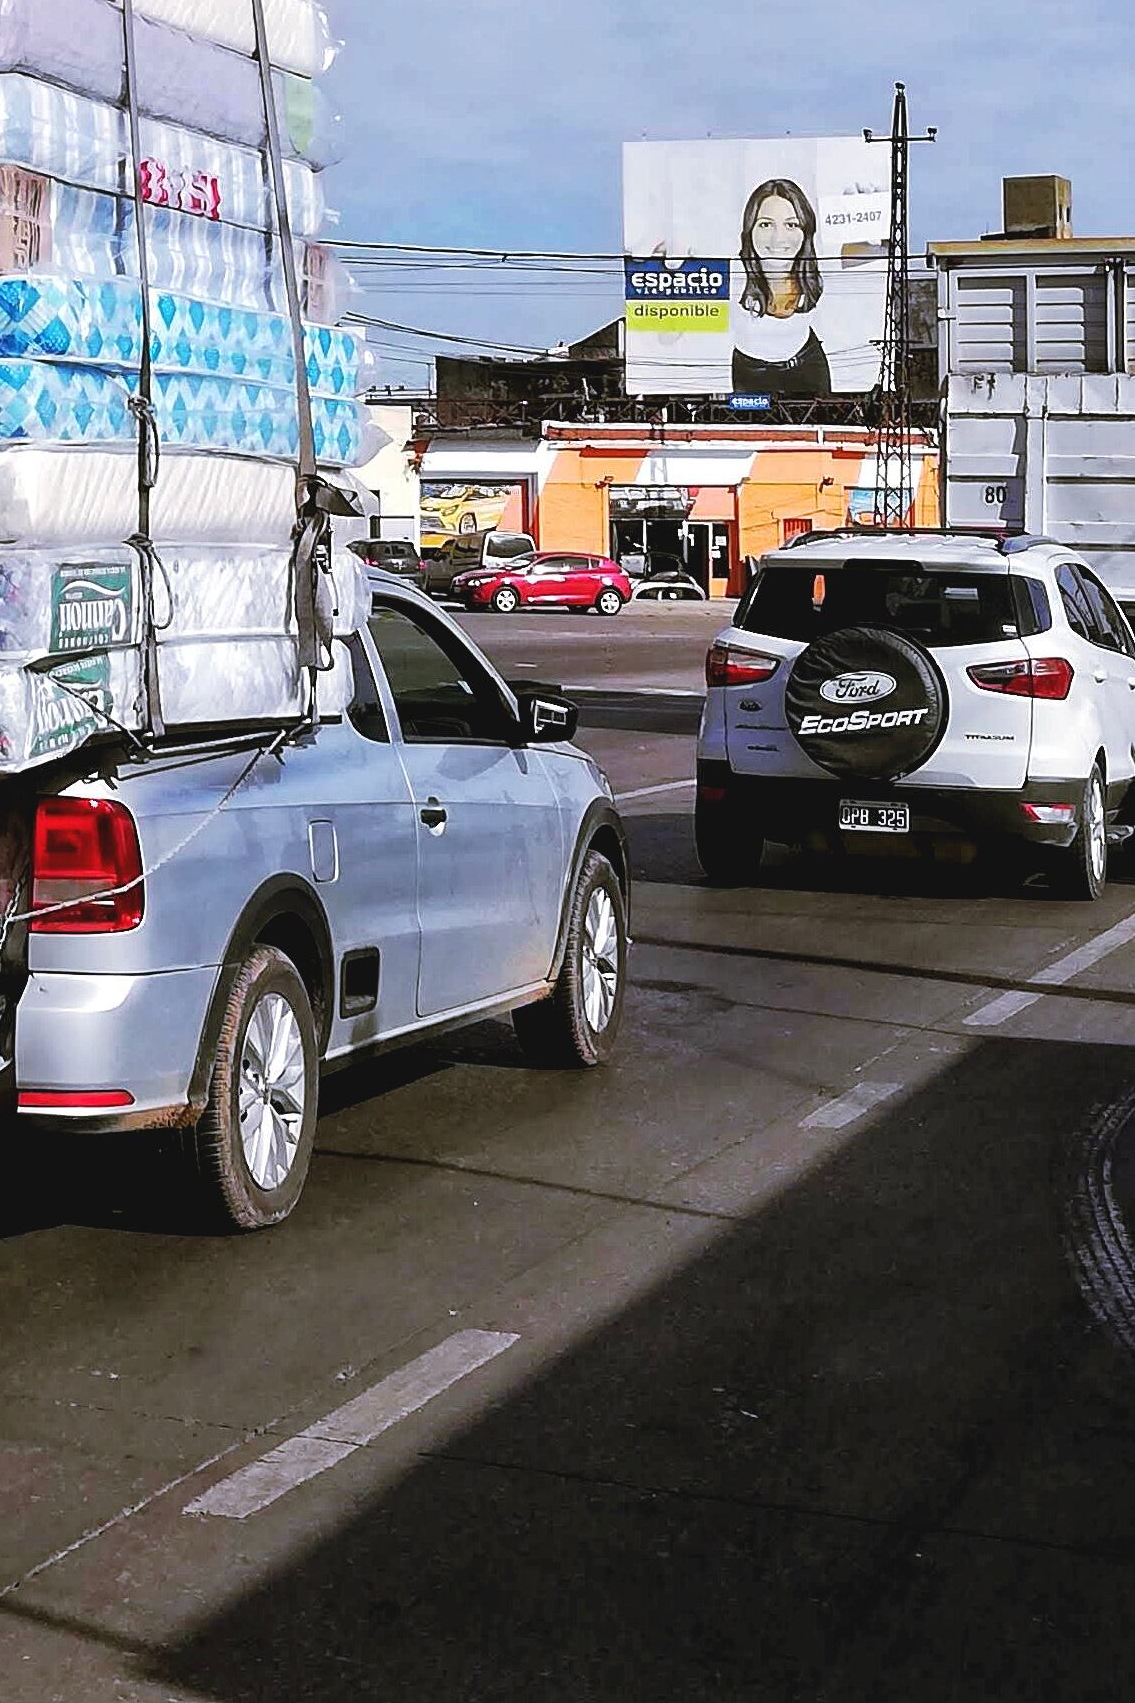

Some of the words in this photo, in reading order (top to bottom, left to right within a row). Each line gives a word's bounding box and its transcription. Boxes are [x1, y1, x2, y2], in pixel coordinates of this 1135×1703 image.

[825, 211, 882, 225] 4231-2407
[631, 267, 723, 291] espacio
[634, 305, 720, 319] disponible
[984, 485, 1007, 504] 80
[59, 598, 126, 641] Cannon
[831, 677, 882, 698] Ford
[878, 809, 905, 827] 325
